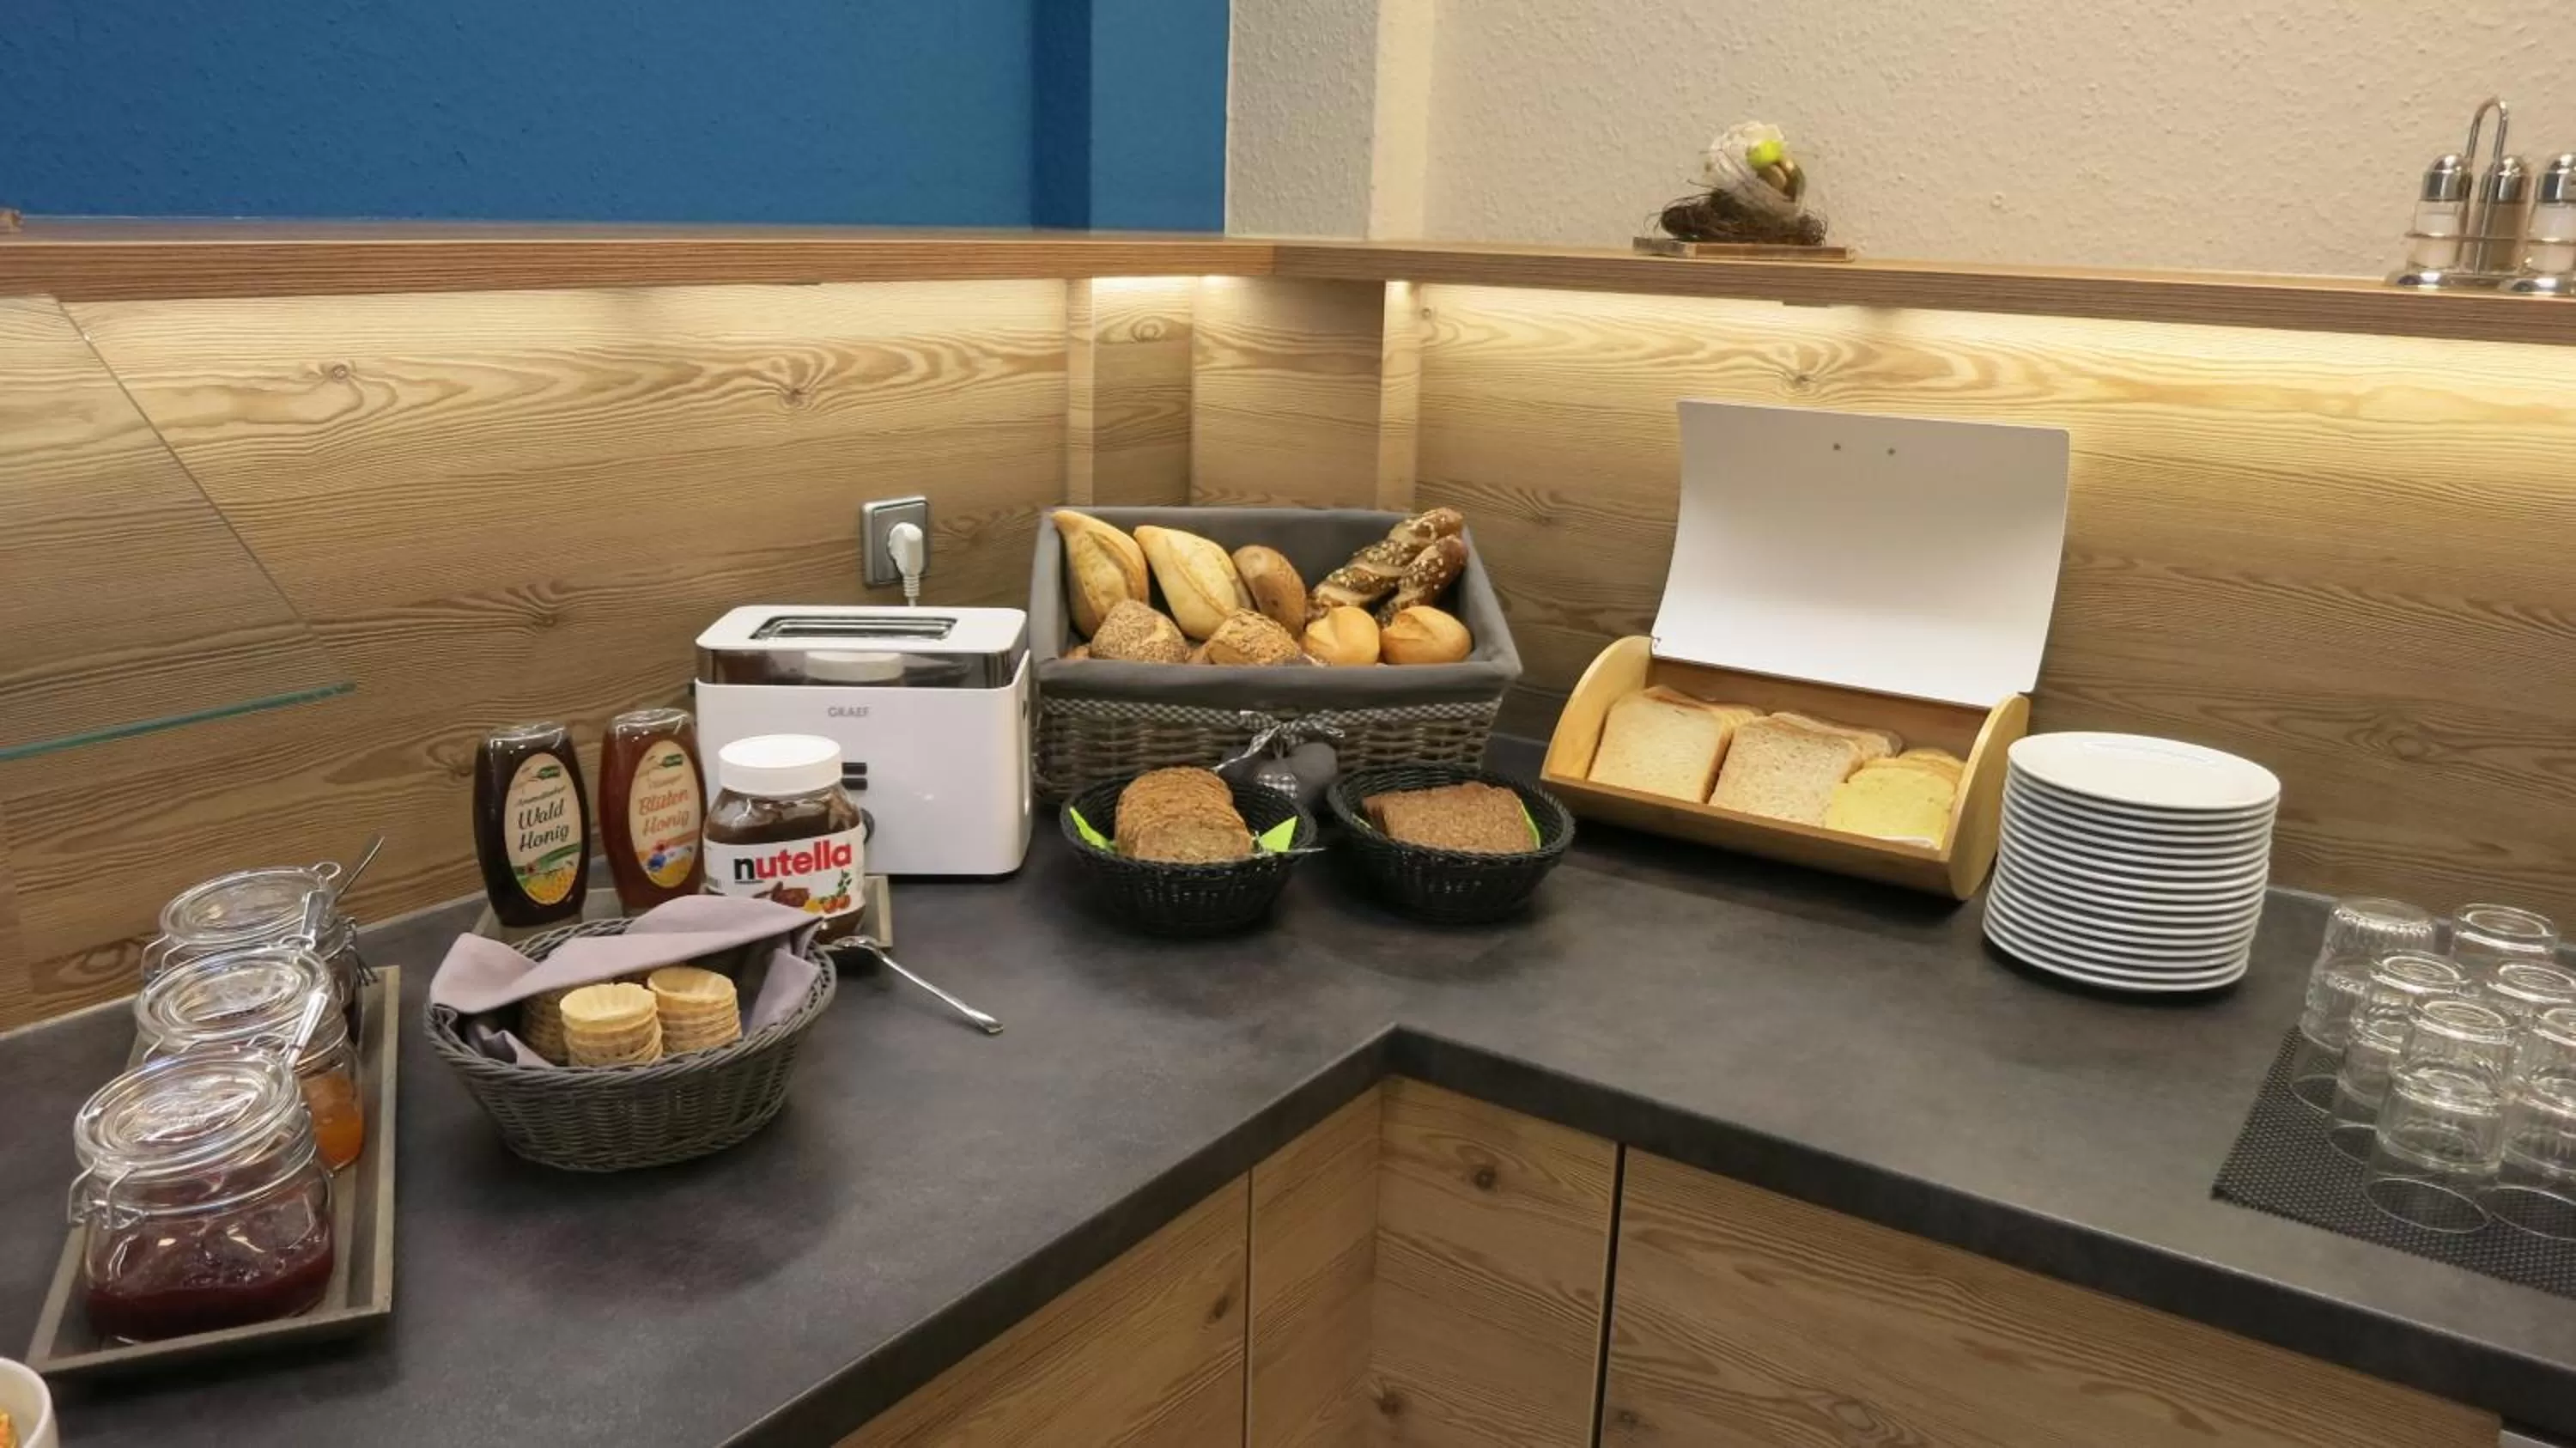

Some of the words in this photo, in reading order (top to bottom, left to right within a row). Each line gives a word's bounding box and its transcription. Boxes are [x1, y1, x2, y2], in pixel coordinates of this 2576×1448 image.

[827, 706, 870, 717] GRAEF
[518, 797, 565, 830] Wald
[641, 811, 690, 837] Honig
[519, 824, 569, 852] Honig
[733, 840, 853, 880] nutella
